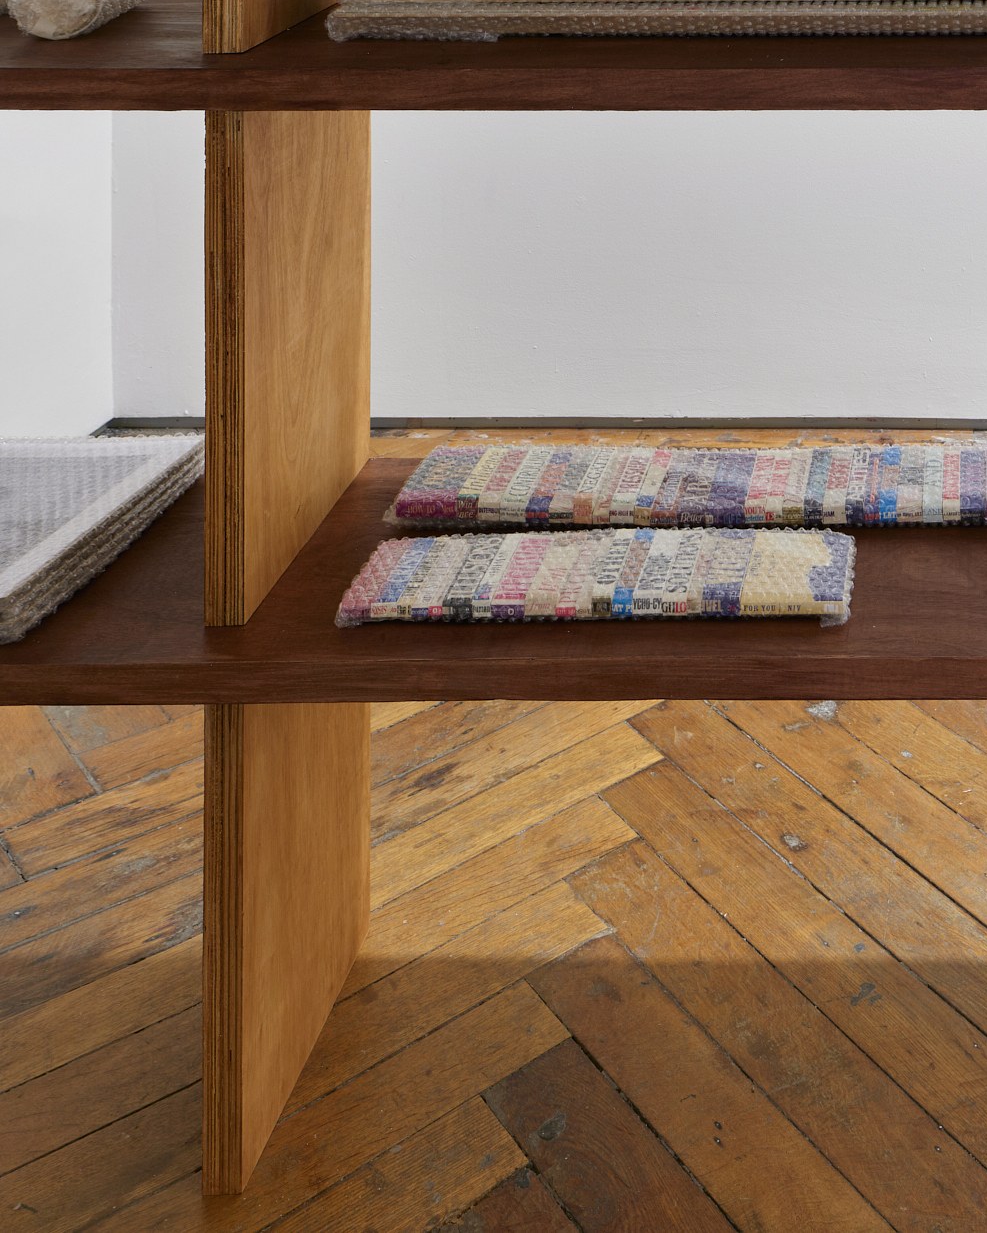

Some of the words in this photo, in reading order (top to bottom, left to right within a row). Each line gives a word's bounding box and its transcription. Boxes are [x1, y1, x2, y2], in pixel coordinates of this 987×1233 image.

[847, 447, 872, 502] ABILITIES
[449, 537, 504, 597] ILLUSIONS
[596, 537, 632, 585] OTHER
[665, 531, 701, 593] SOLUTIONS
[743, 604, 758, 613] FOR
[761, 603, 777, 613] YOU
